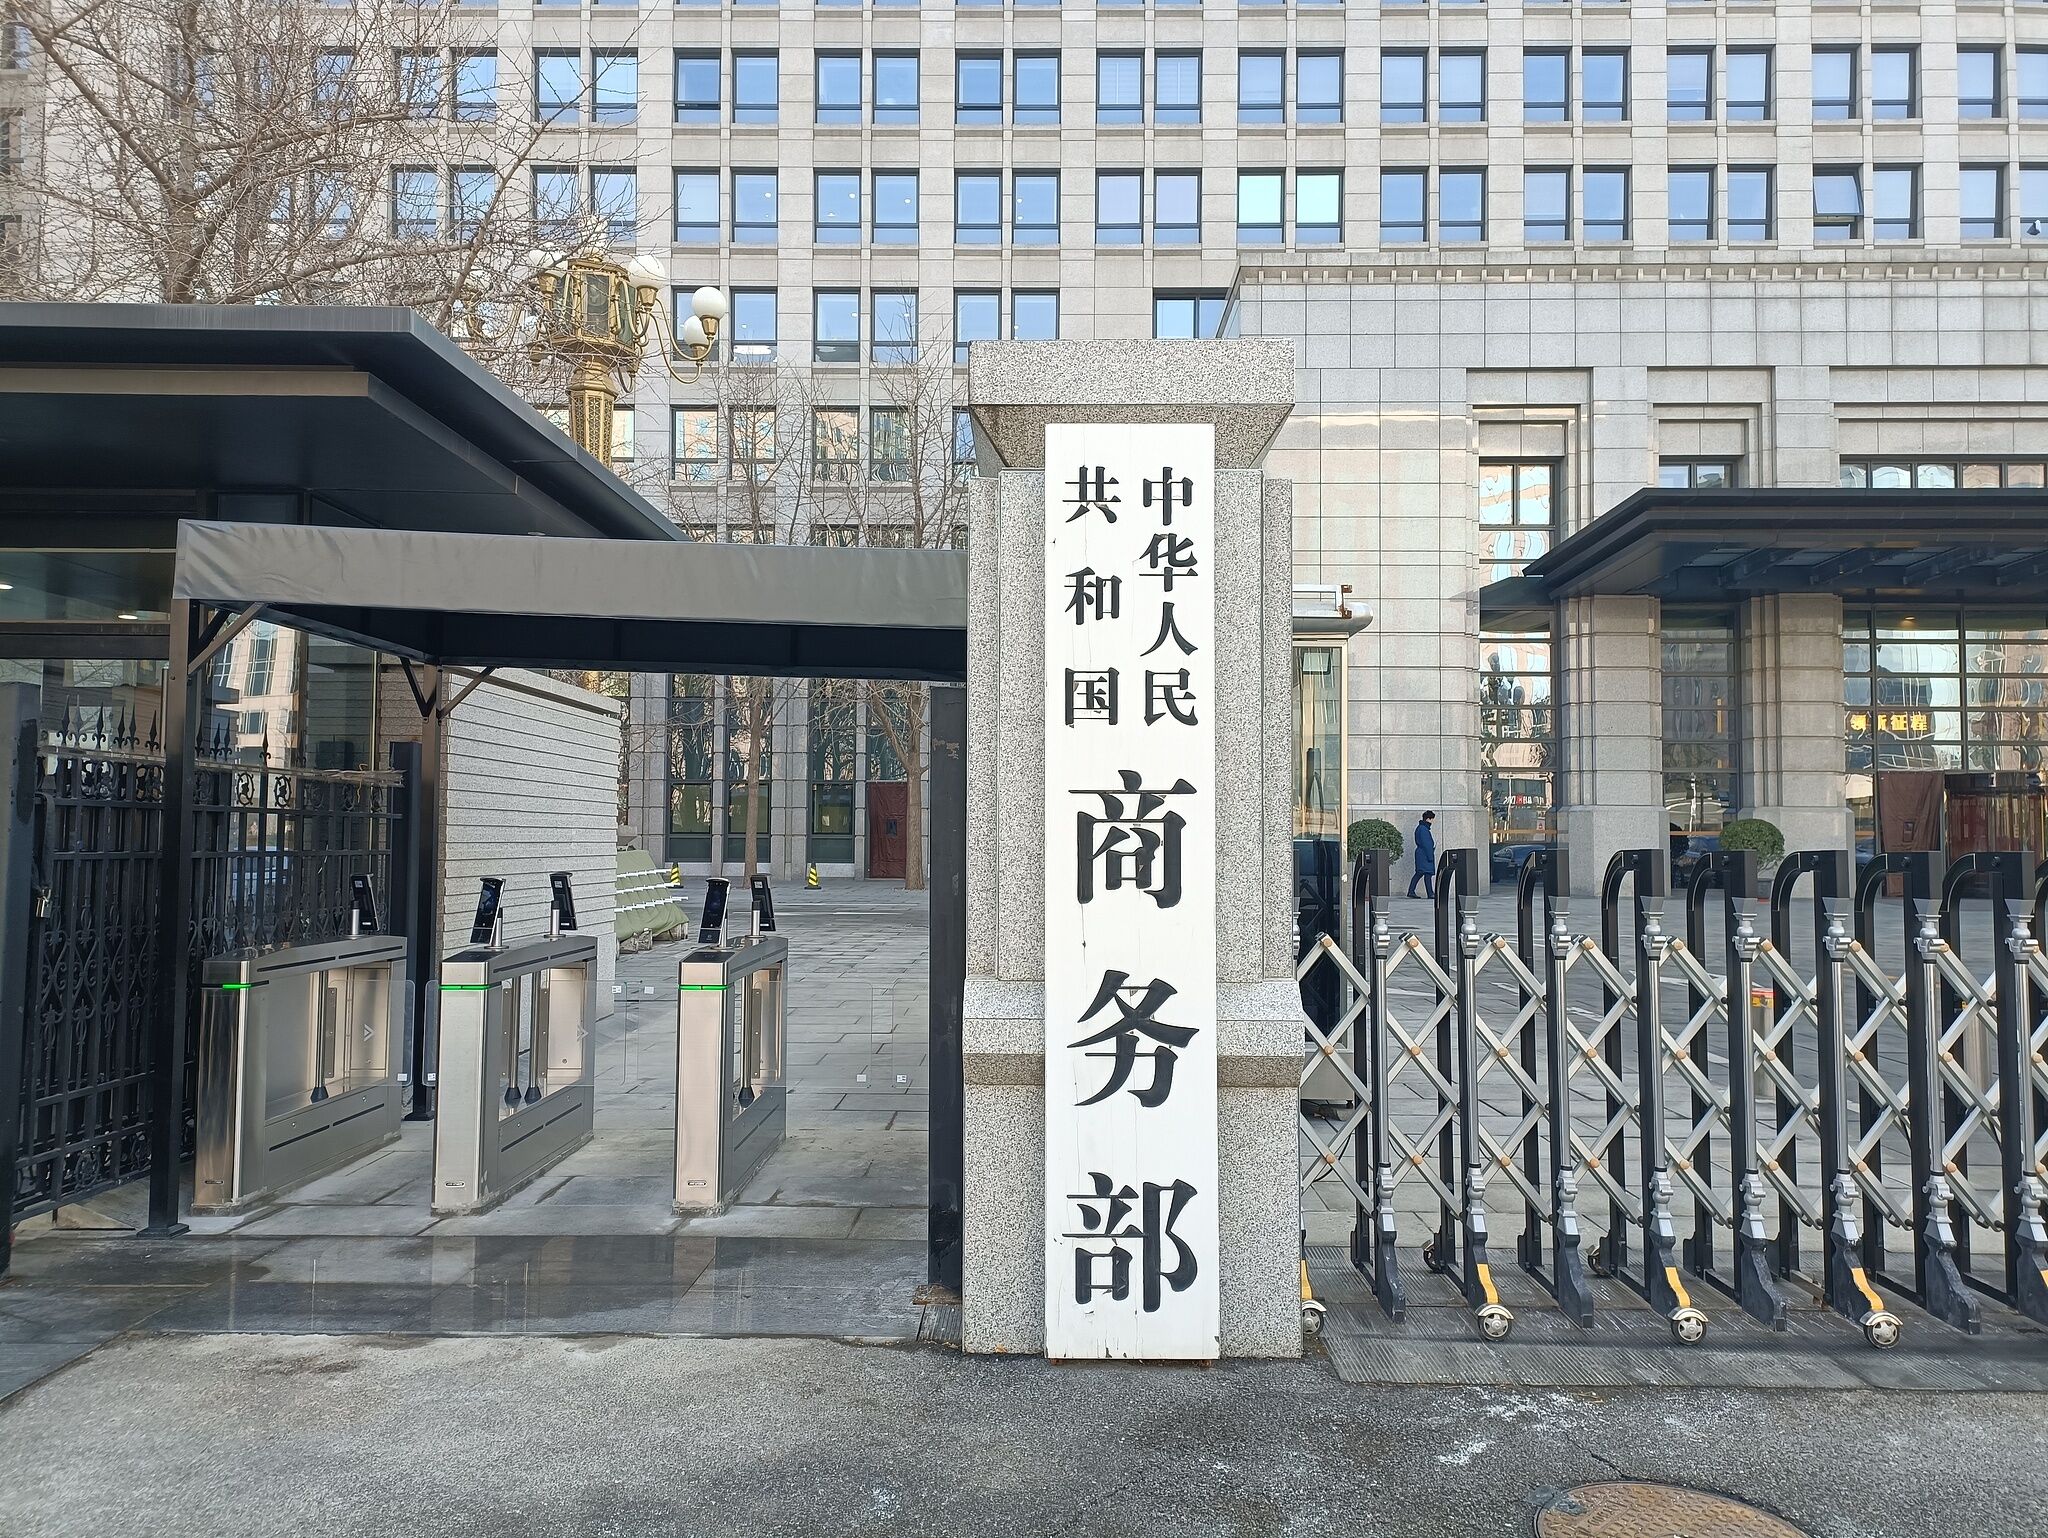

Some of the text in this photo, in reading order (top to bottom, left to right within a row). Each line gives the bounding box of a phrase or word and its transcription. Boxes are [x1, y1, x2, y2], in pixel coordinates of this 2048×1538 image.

[1062, 465, 1122, 727] 共和国
[1139, 466, 1199, 727] 中华人民
[1062, 769, 1199, 1312] 商务部
